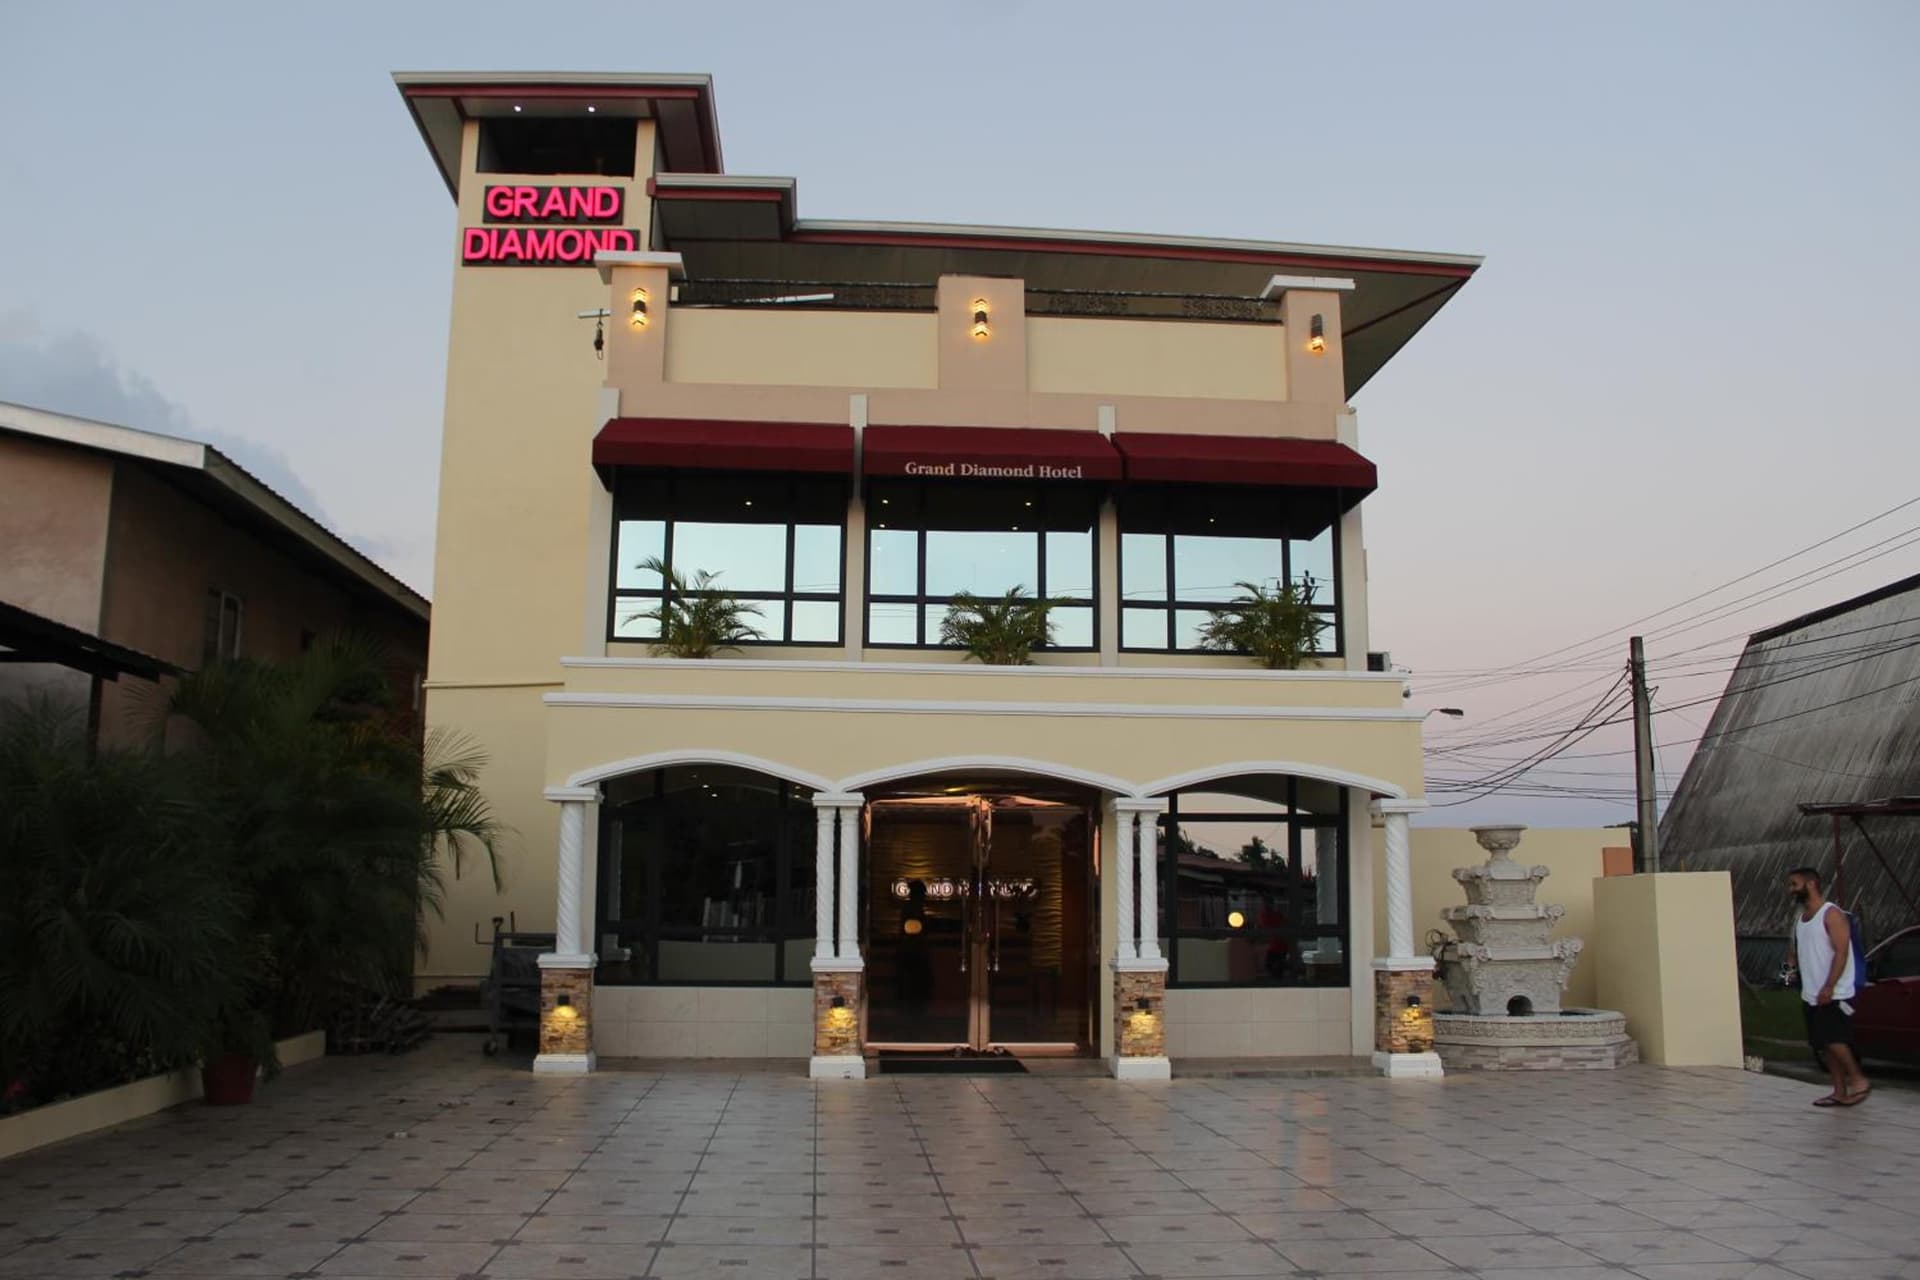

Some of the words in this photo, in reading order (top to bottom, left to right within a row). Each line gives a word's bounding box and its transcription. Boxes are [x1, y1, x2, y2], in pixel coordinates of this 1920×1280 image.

[486, 185, 619, 217] GRAND
[463, 228, 635, 260] DIAMOND
[904, 461, 955, 476] Grand
[960, 463, 1034, 478] Diamond
[1039, 465, 1083, 479] Hotel
